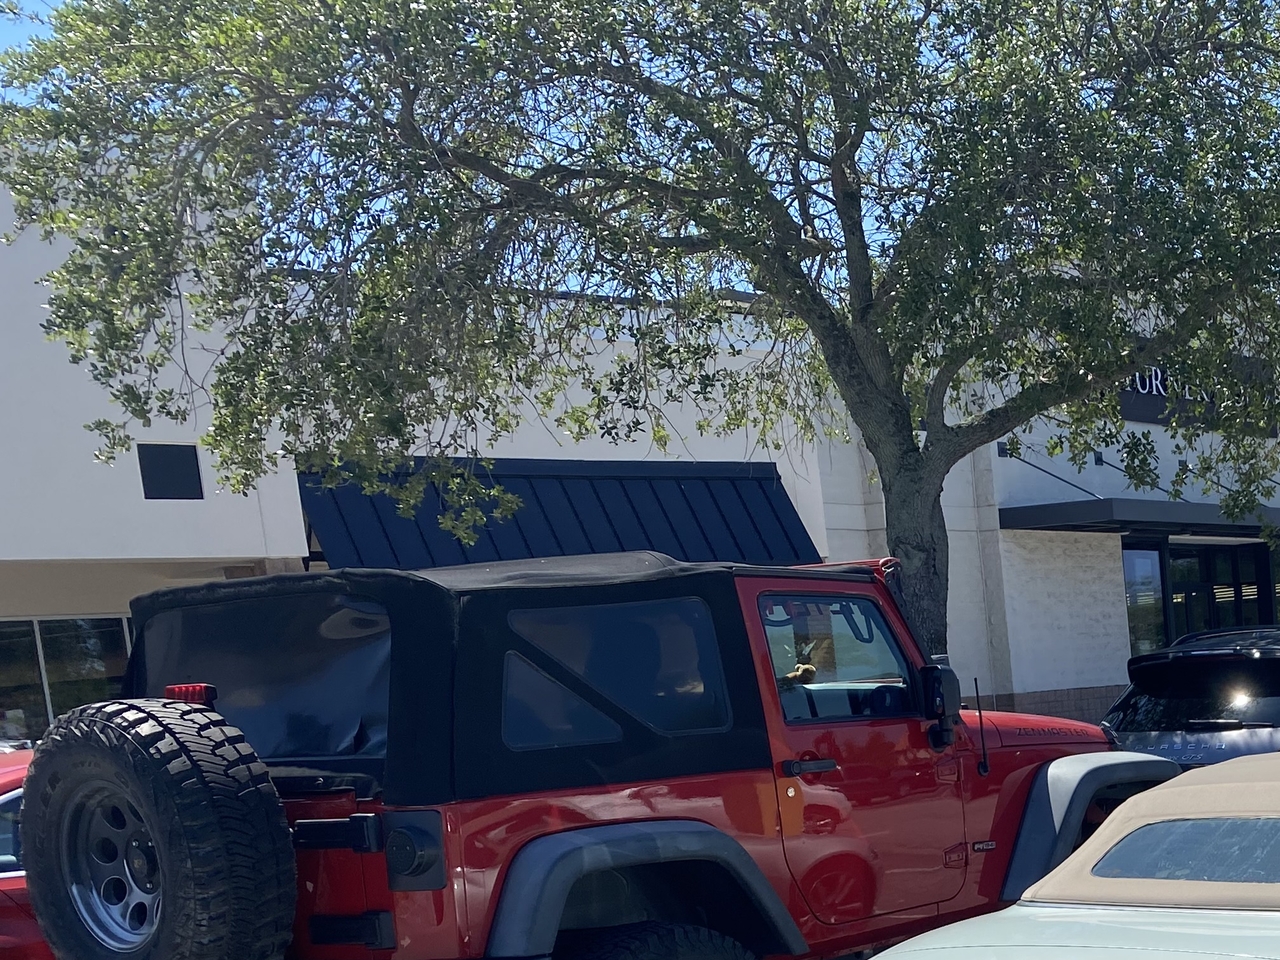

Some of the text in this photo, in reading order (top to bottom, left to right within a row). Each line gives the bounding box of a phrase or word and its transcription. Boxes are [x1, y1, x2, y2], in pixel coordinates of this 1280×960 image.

[1015, 727, 1089, 737] ZENMASTER
[1134, 742, 1226, 751] PORSCHE
[1181, 752, 1204, 761] GTS
